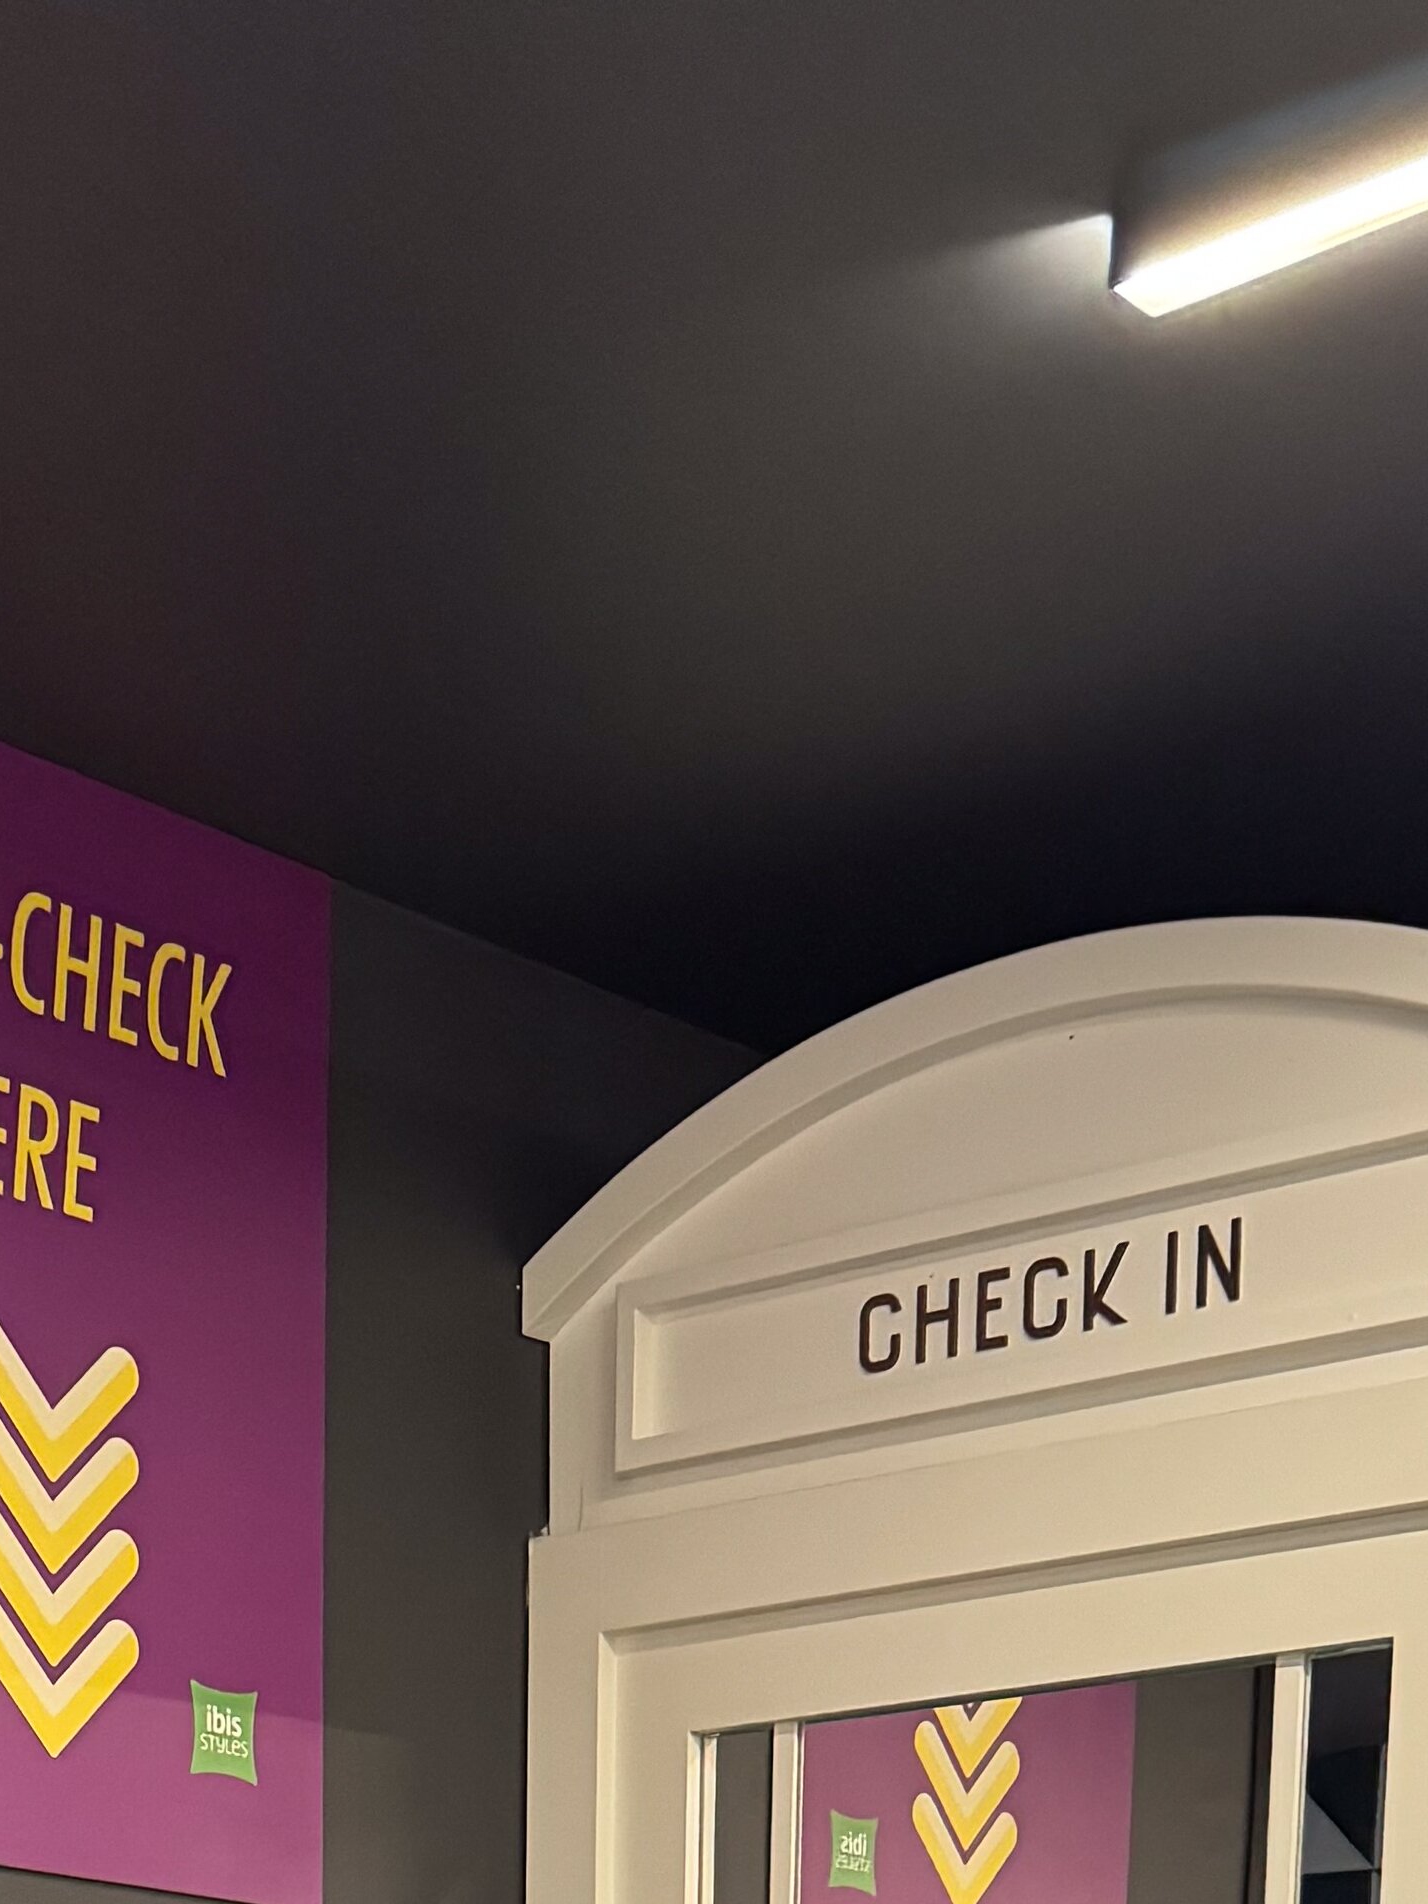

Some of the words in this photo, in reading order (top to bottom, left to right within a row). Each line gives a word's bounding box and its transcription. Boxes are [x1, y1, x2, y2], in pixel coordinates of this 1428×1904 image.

[859, 1240, 1130, 1375] CHECK
[1164, 1216, 1243, 1314] IN
[206, 1704, 243, 1738] ibis
